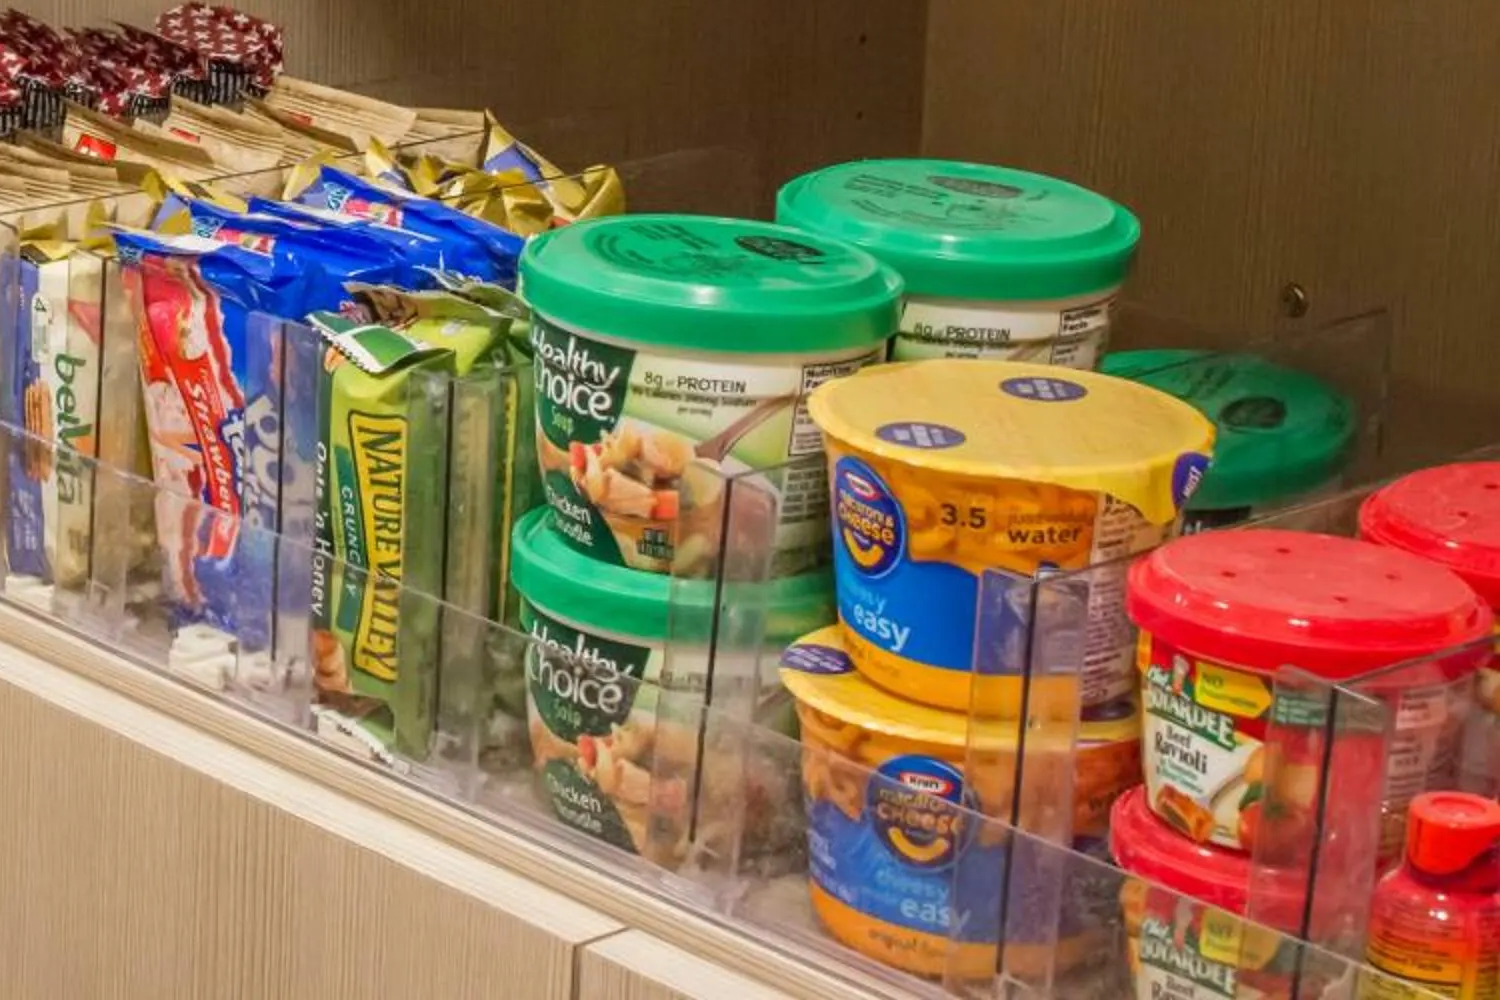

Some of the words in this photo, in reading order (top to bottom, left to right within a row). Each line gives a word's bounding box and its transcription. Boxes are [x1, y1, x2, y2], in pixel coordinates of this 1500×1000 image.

[946, 325, 1011, 342] PROTEIN
[677, 375, 747, 393] PROTEIN
[357, 425, 403, 552] NATURE
[940, 503, 986, 529] 3.5
[1007, 525, 1082, 545] water
[310, 537, 331, 617] Honey
[853, 603, 911, 652] easy
[901, 897, 972, 934] easy
